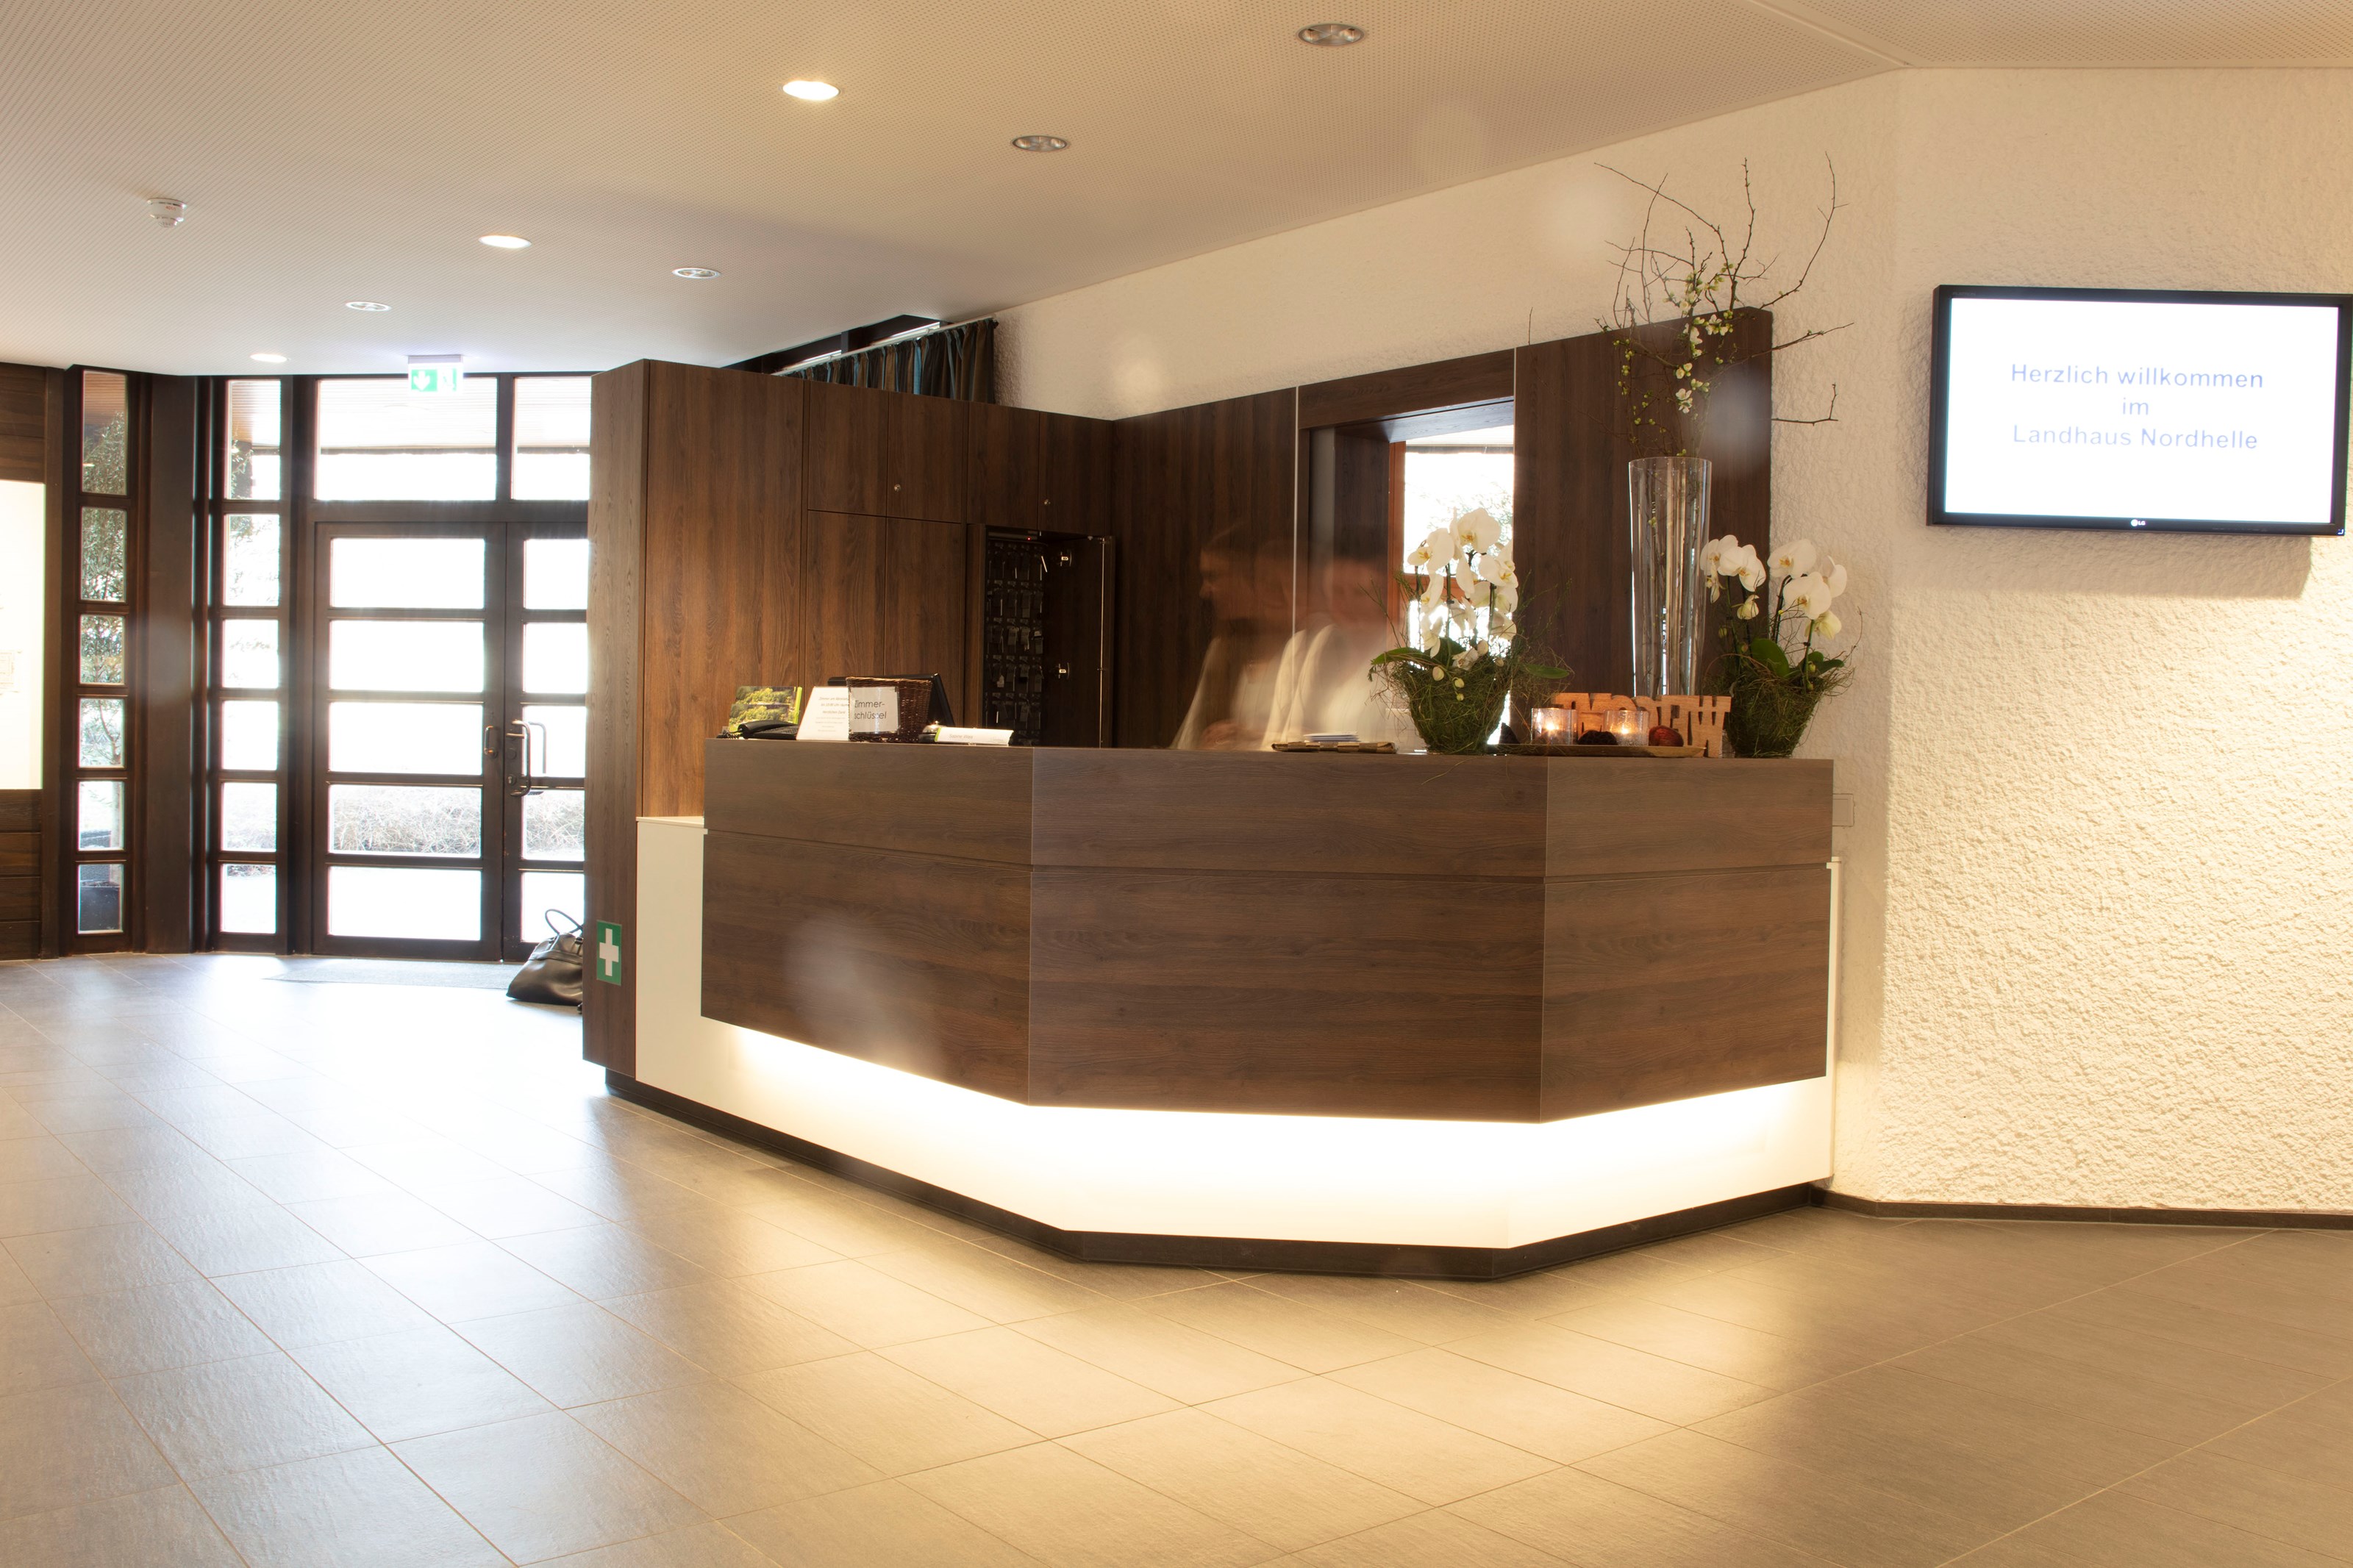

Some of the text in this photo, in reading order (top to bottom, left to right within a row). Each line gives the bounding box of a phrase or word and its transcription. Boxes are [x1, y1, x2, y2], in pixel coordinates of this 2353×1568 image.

[2012, 364, 2263, 388] Herzlich willkommen
[2122, 397, 2149, 415] im
[2014, 424, 2257, 449] Landhaus Nordhelle
[855, 700, 885, 708] Zimmer-
[854, 711, 887, 720] schlüssel
